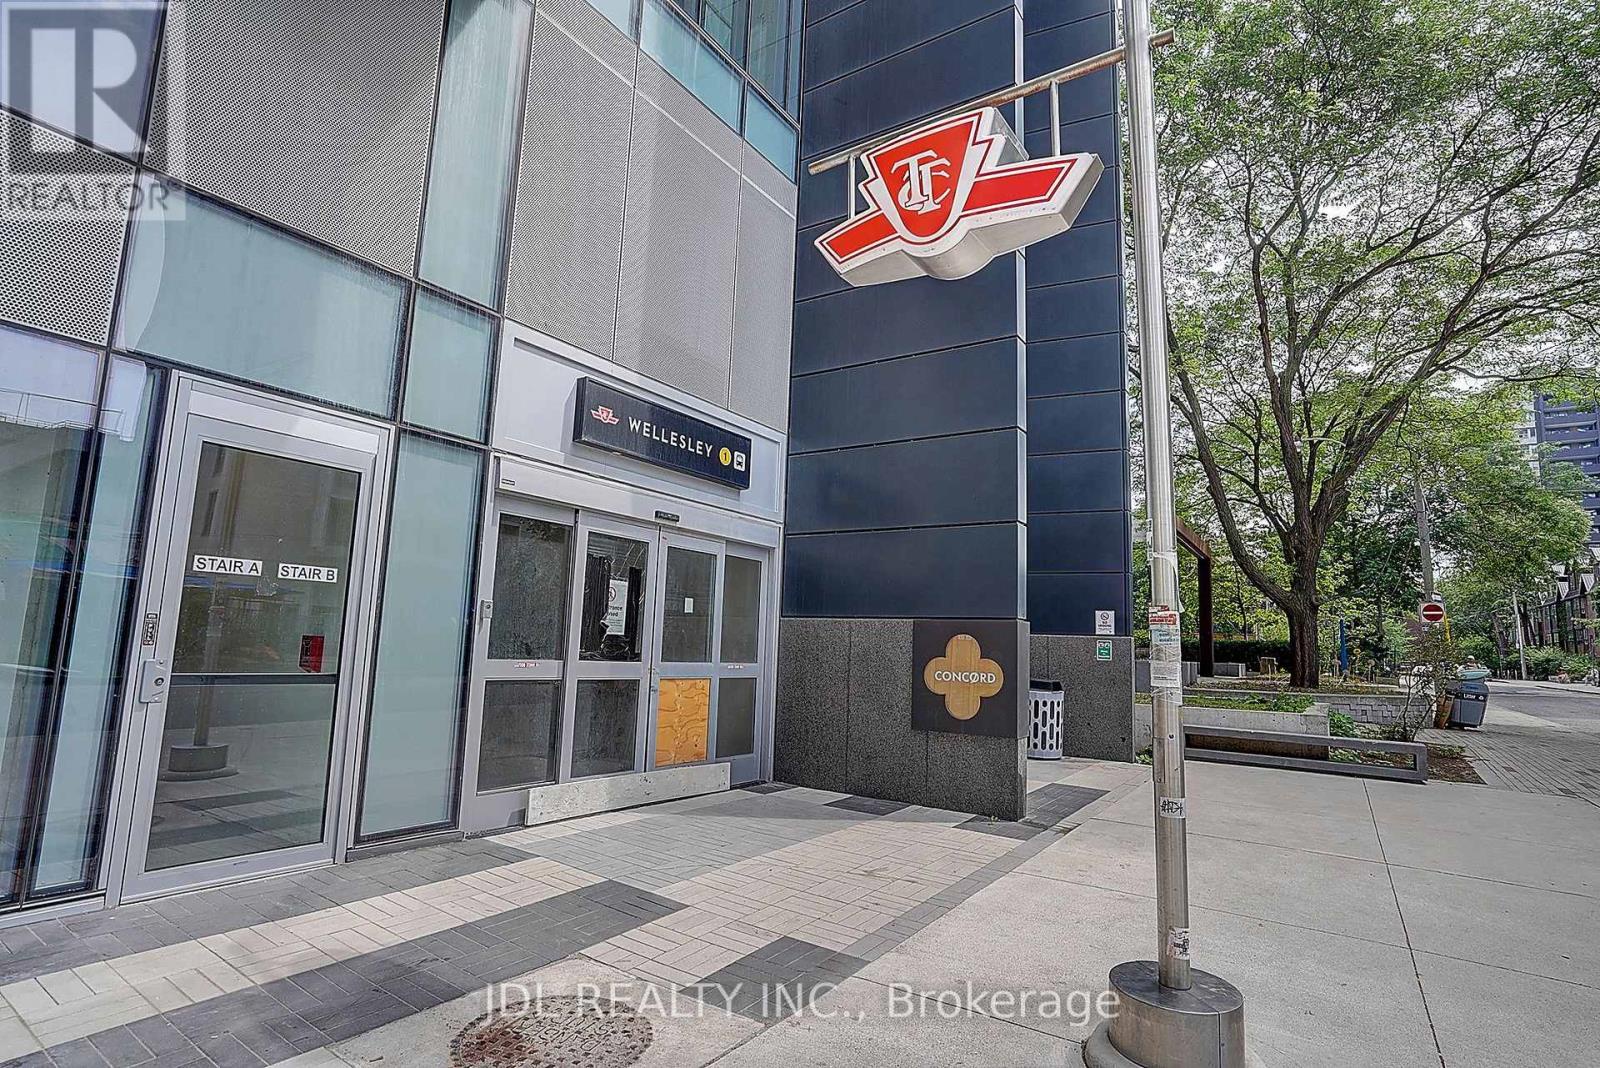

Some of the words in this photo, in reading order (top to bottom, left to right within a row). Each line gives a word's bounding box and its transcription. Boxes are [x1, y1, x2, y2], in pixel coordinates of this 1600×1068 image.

[628, 416, 713, 458] WELLESLEY
[196, 557, 243, 573] STAIR
[248, 562, 259, 574] A
[280, 565, 321, 580] STAIR
[326, 569, 335, 581] B
